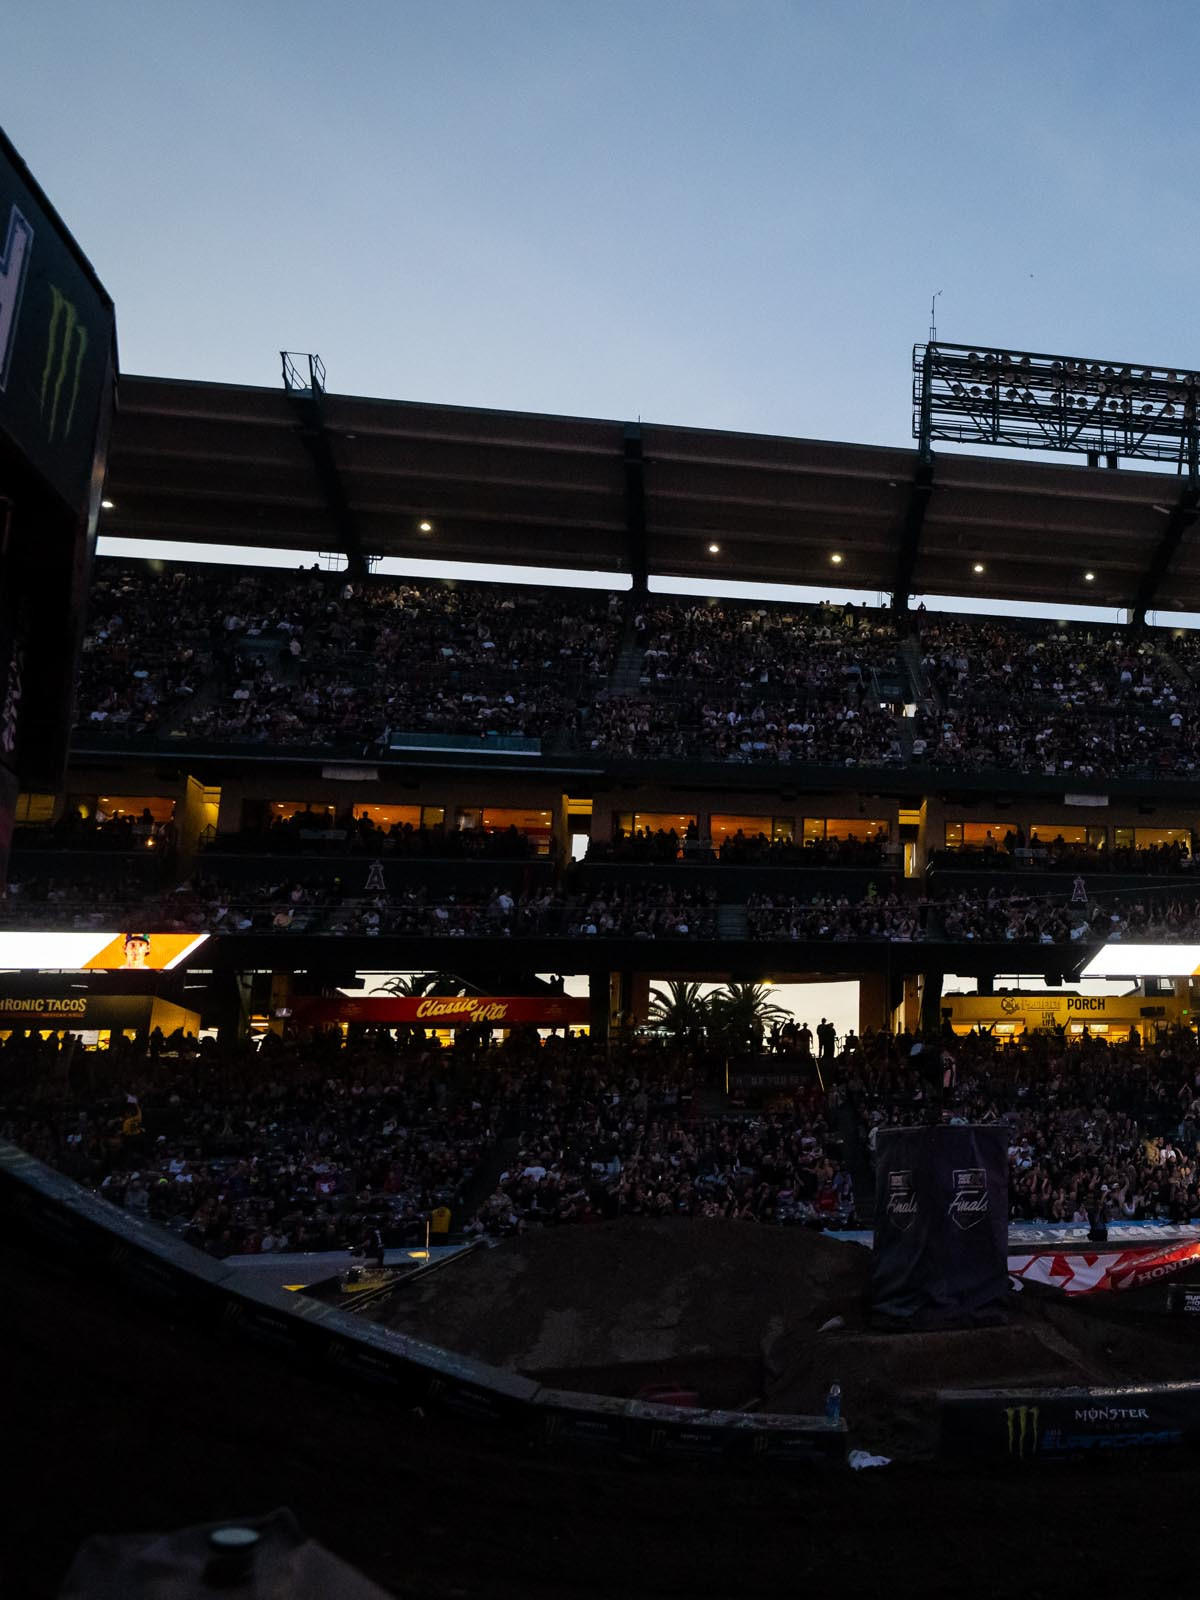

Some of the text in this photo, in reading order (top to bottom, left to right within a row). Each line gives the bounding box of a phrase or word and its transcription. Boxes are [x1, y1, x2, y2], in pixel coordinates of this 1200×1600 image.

[46, 998, 87, 1012] TACOS
[416, 999, 508, 1022] Classic Hits
[1067, 998, 1105, 1010] PORCH
[948, 1191, 990, 1215] Finals
[1137, 1254, 1200, 1281] HONDA
[1074, 1406, 1150, 1423] MONSTER
